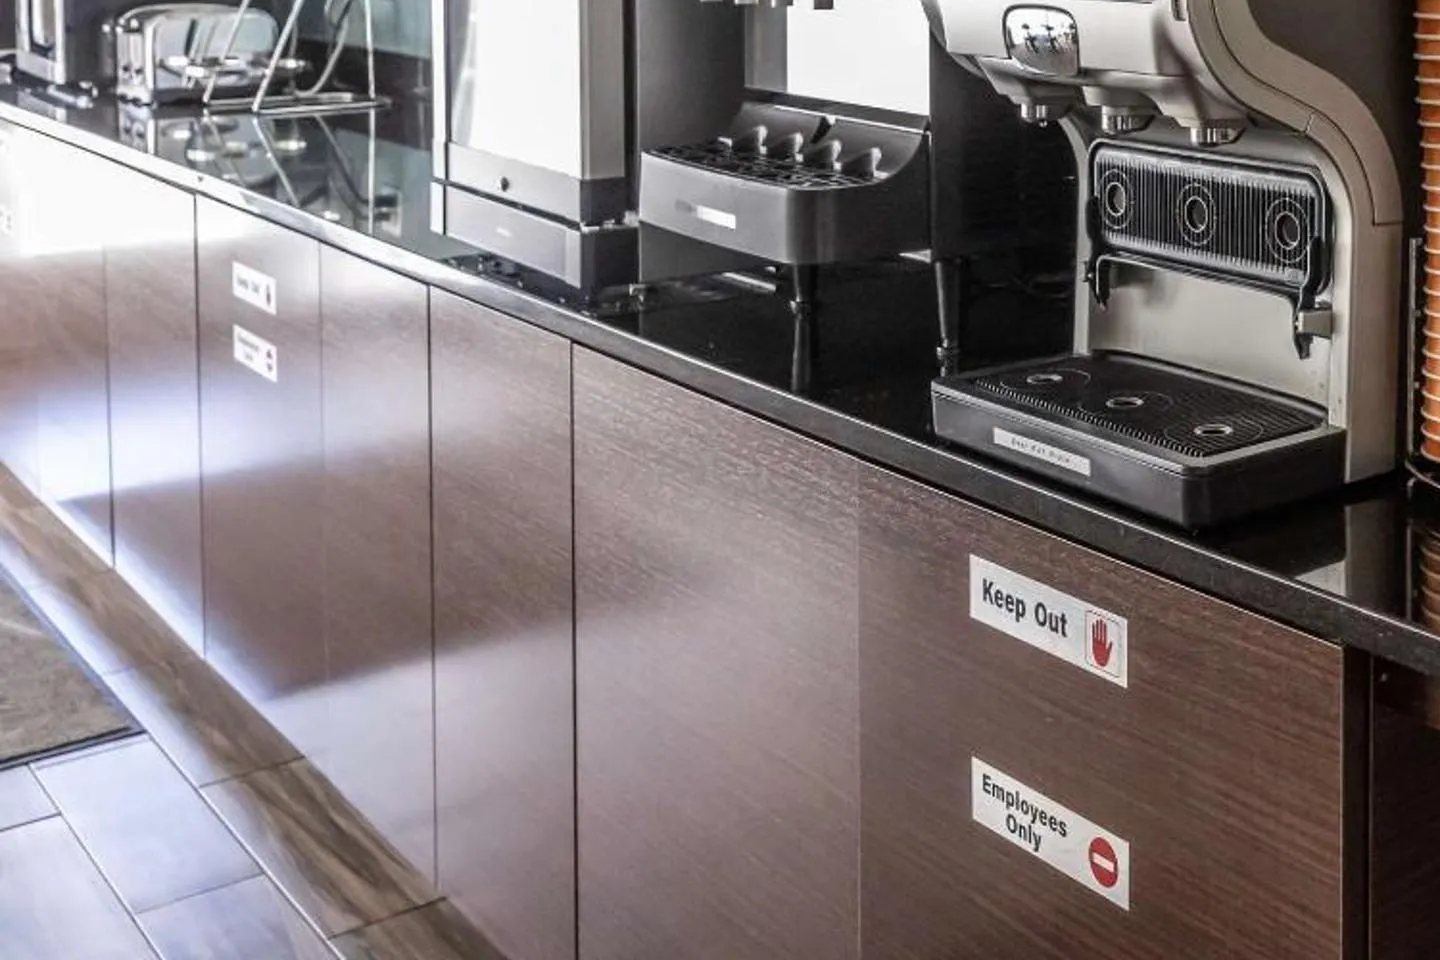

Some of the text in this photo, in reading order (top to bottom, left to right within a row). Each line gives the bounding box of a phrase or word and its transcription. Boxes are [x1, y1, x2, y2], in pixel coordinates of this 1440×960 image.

[981, 577, 1069, 639] Keep Out
[981, 773, 1068, 838] Employees
[1005, 813, 1043, 853] Only
